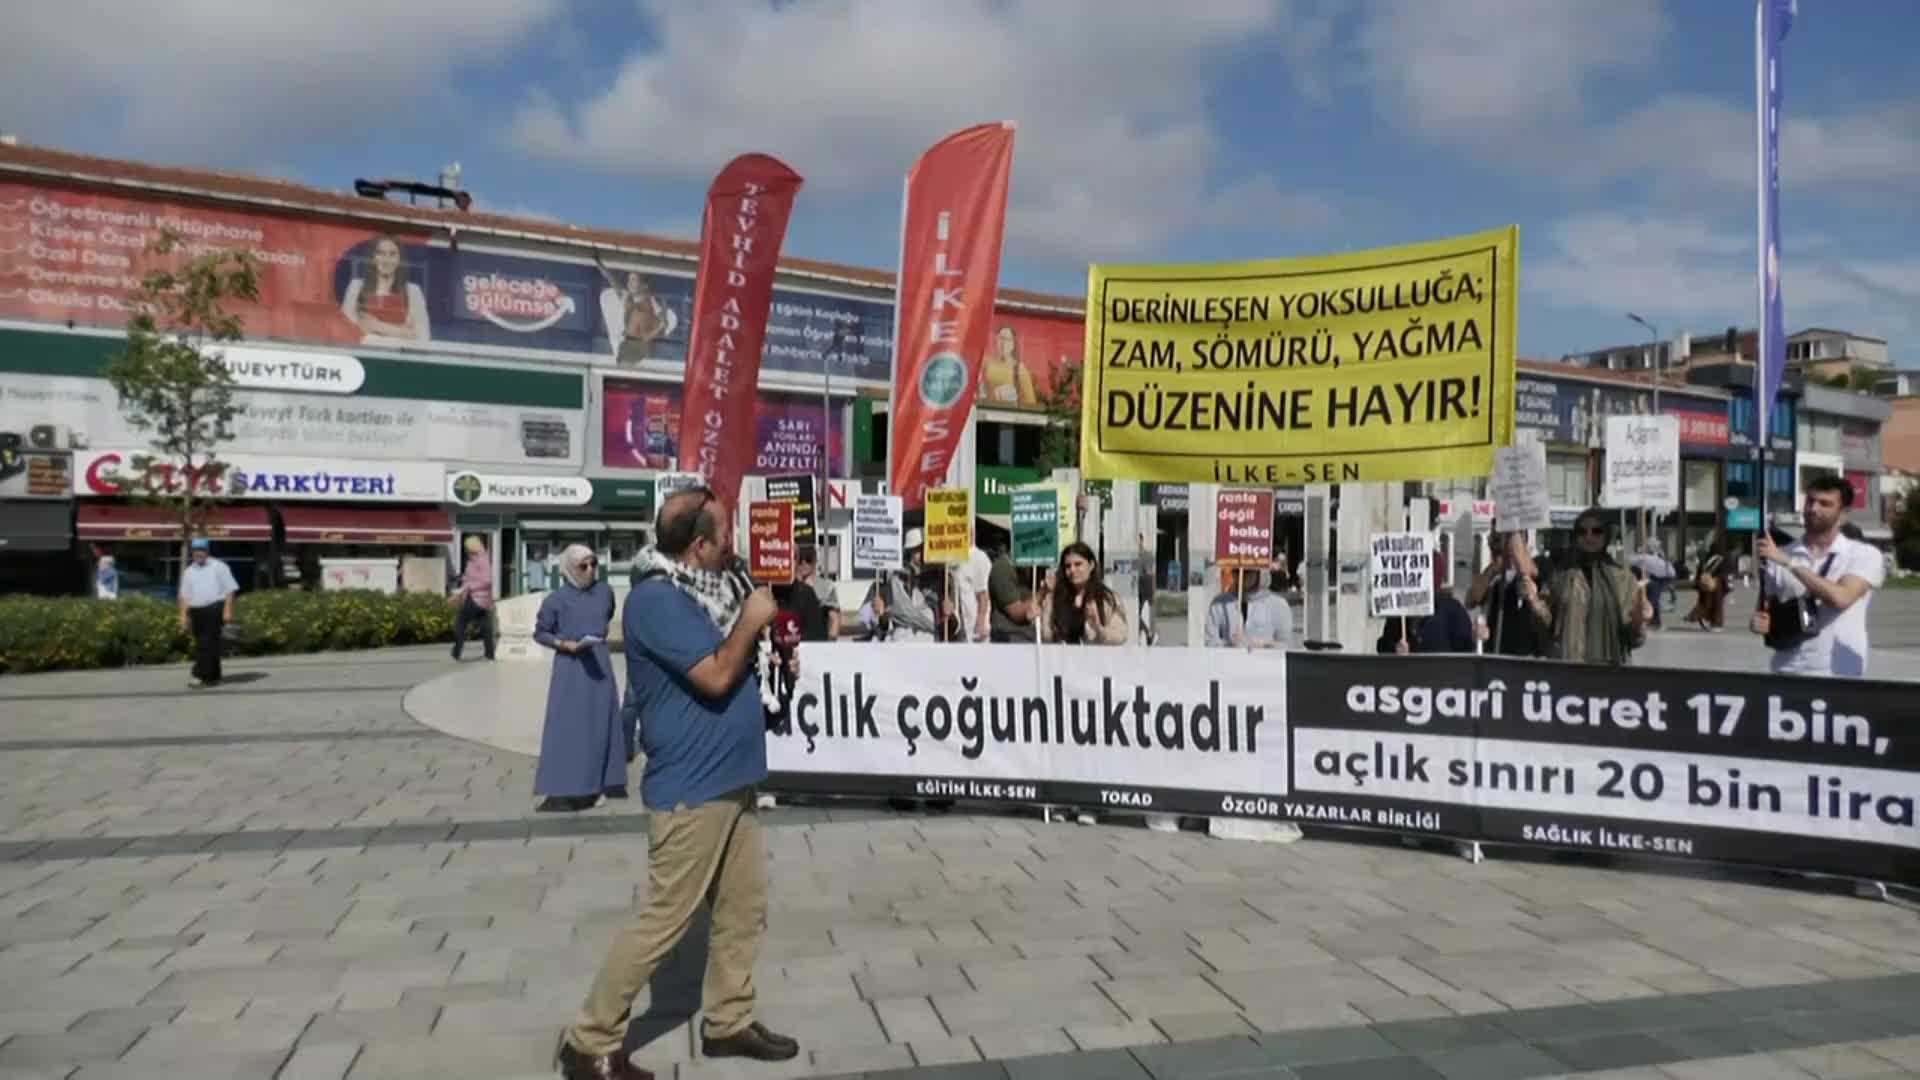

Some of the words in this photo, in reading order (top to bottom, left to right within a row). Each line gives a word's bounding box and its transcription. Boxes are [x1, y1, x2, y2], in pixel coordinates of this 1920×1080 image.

[463, 273, 561, 297] geleceğe
[928, 210, 966, 344] İLKE
[465, 291, 558, 316] gülümse
[1111, 292, 1269, 329] DERİNLEŞEN
[1279, 269, 1483, 320] YOKSULLUĞA;
[711, 297, 741, 400] ADALET
[1109, 339, 1183, 374] ZAM,
[1192, 324, 1340, 369] SÖMÜRÜ,
[1352, 316, 1483, 360] YAĞMA
[1106, 381, 1313, 431] DÜZENİNE
[1327, 375, 1482, 427] HAYIR!
[698, 409, 723, 480] ÖZGÜ
[1213, 460, 1360, 482] İLKE-SEN
[1219, 492, 1257, 504] ranta
[1218, 508, 1255, 522] değil
[1229, 525, 1270, 539] halka
[1229, 542, 1269, 557] bütçe
[1380, 553, 1430, 569] vuran
[1373, 570, 1423, 588] zamlar
[896, 676, 1264, 760] çoğunluktadır
[1346, 681, 1504, 724] asgarî
[1522, 681, 1667, 731] ücret
[1686, 693, 1746, 737] 17
[1767, 696, 1891, 756] bin,
[916, 779, 966, 796] EĞİTİM
[969, 781, 1036, 799] İLKE-SEN
[1101, 790, 1153, 807] TOKAD
[1313, 742, 1430, 787] açlık
[1448, 759, 1574, 795] sınırı
[1596, 760, 1665, 802] 20
[1687, 763, 1782, 813] bin
[1807, 775, 1915, 827] lira
[1221, 795, 1279, 816] ÖZGÜR
[1284, 803, 1372, 823] YAZARLAR
[1377, 808, 1441, 830] BİRLİĞİ
[1523, 822, 1592, 846] SAĞLIK
[1598, 827, 1693, 854] İLKE-SEN
